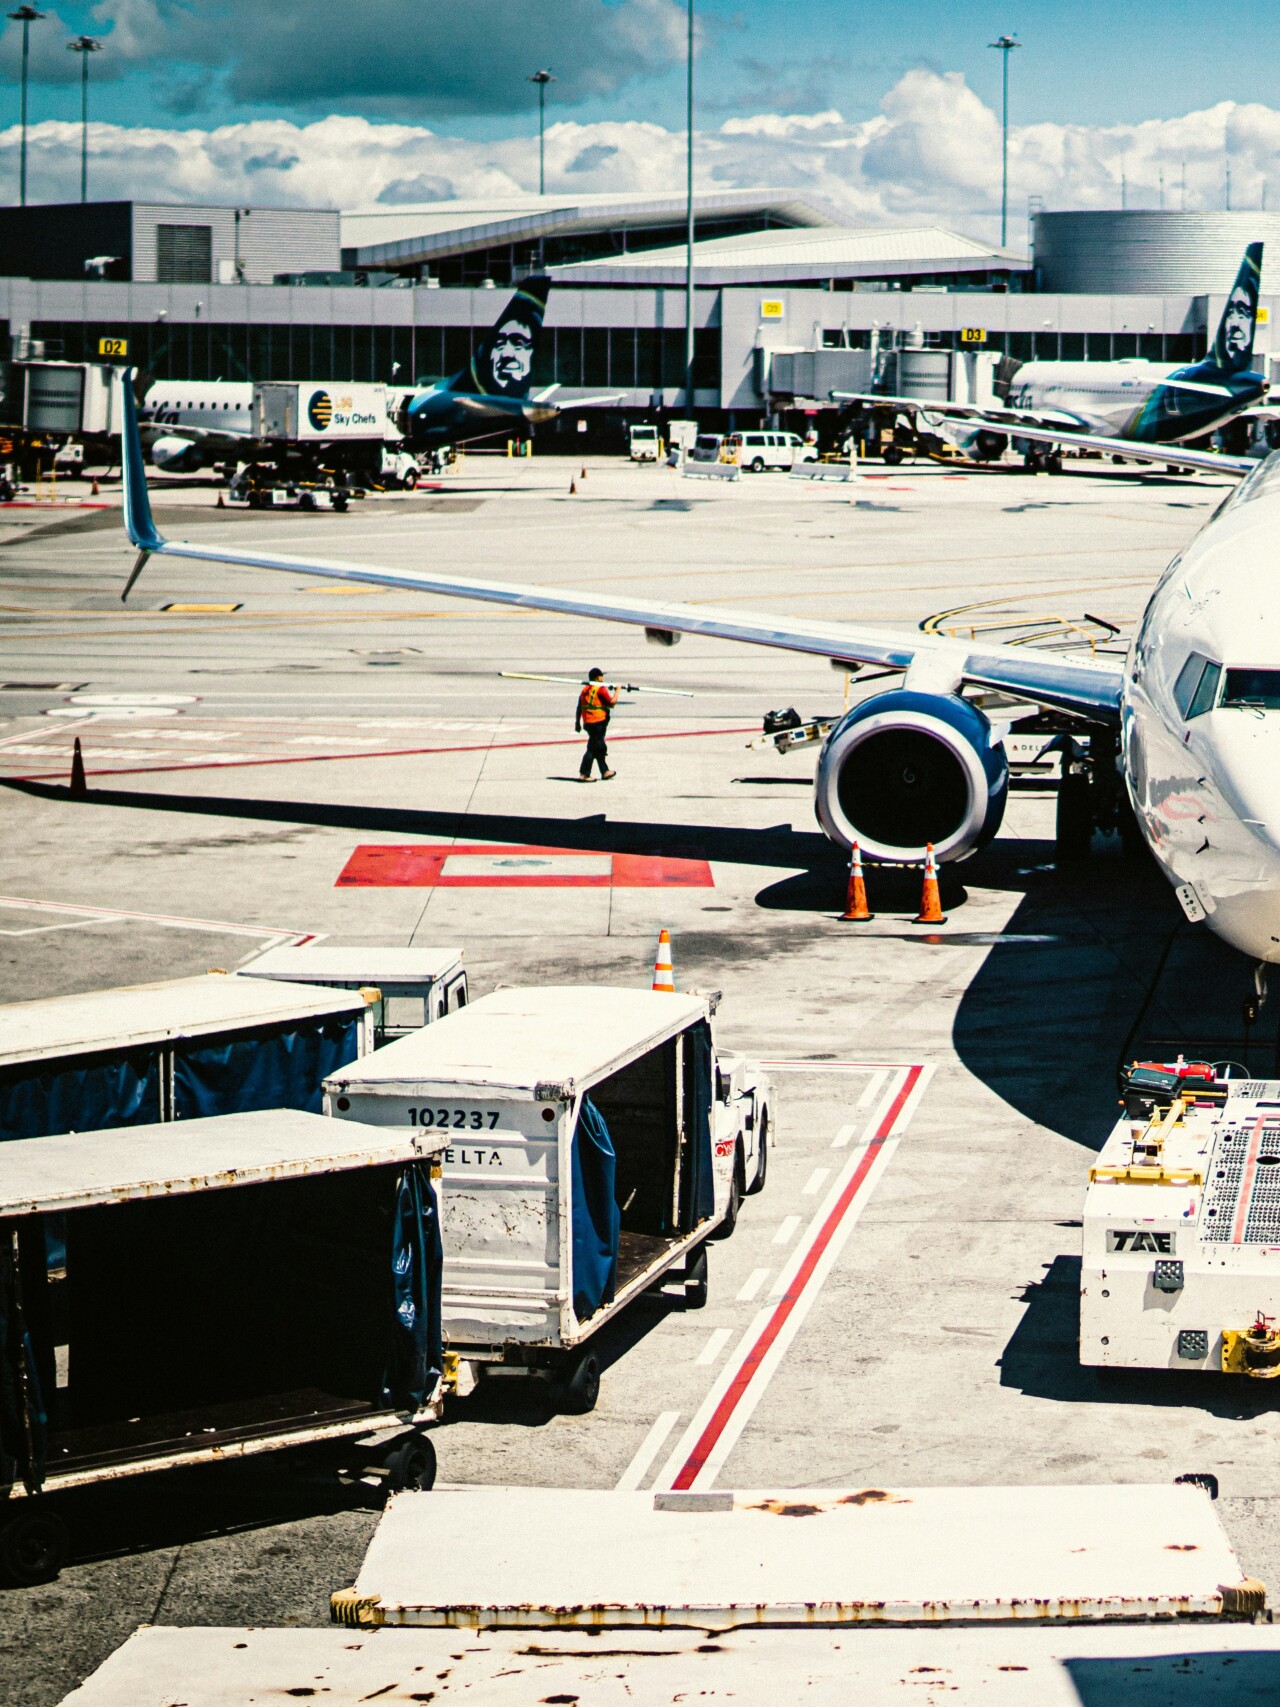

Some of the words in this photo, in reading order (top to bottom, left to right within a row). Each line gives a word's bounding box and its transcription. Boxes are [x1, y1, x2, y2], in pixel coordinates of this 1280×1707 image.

[966, 329, 981, 341] D3
[104, 340, 121, 354] D2
[334, 413, 350, 426] Sky
[351, 413, 376, 424] Chefs
[407, 1107, 500, 1131] 102237
[443, 1149, 503, 1166] ELTA
[1112, 1230, 1171, 1254] TAE
